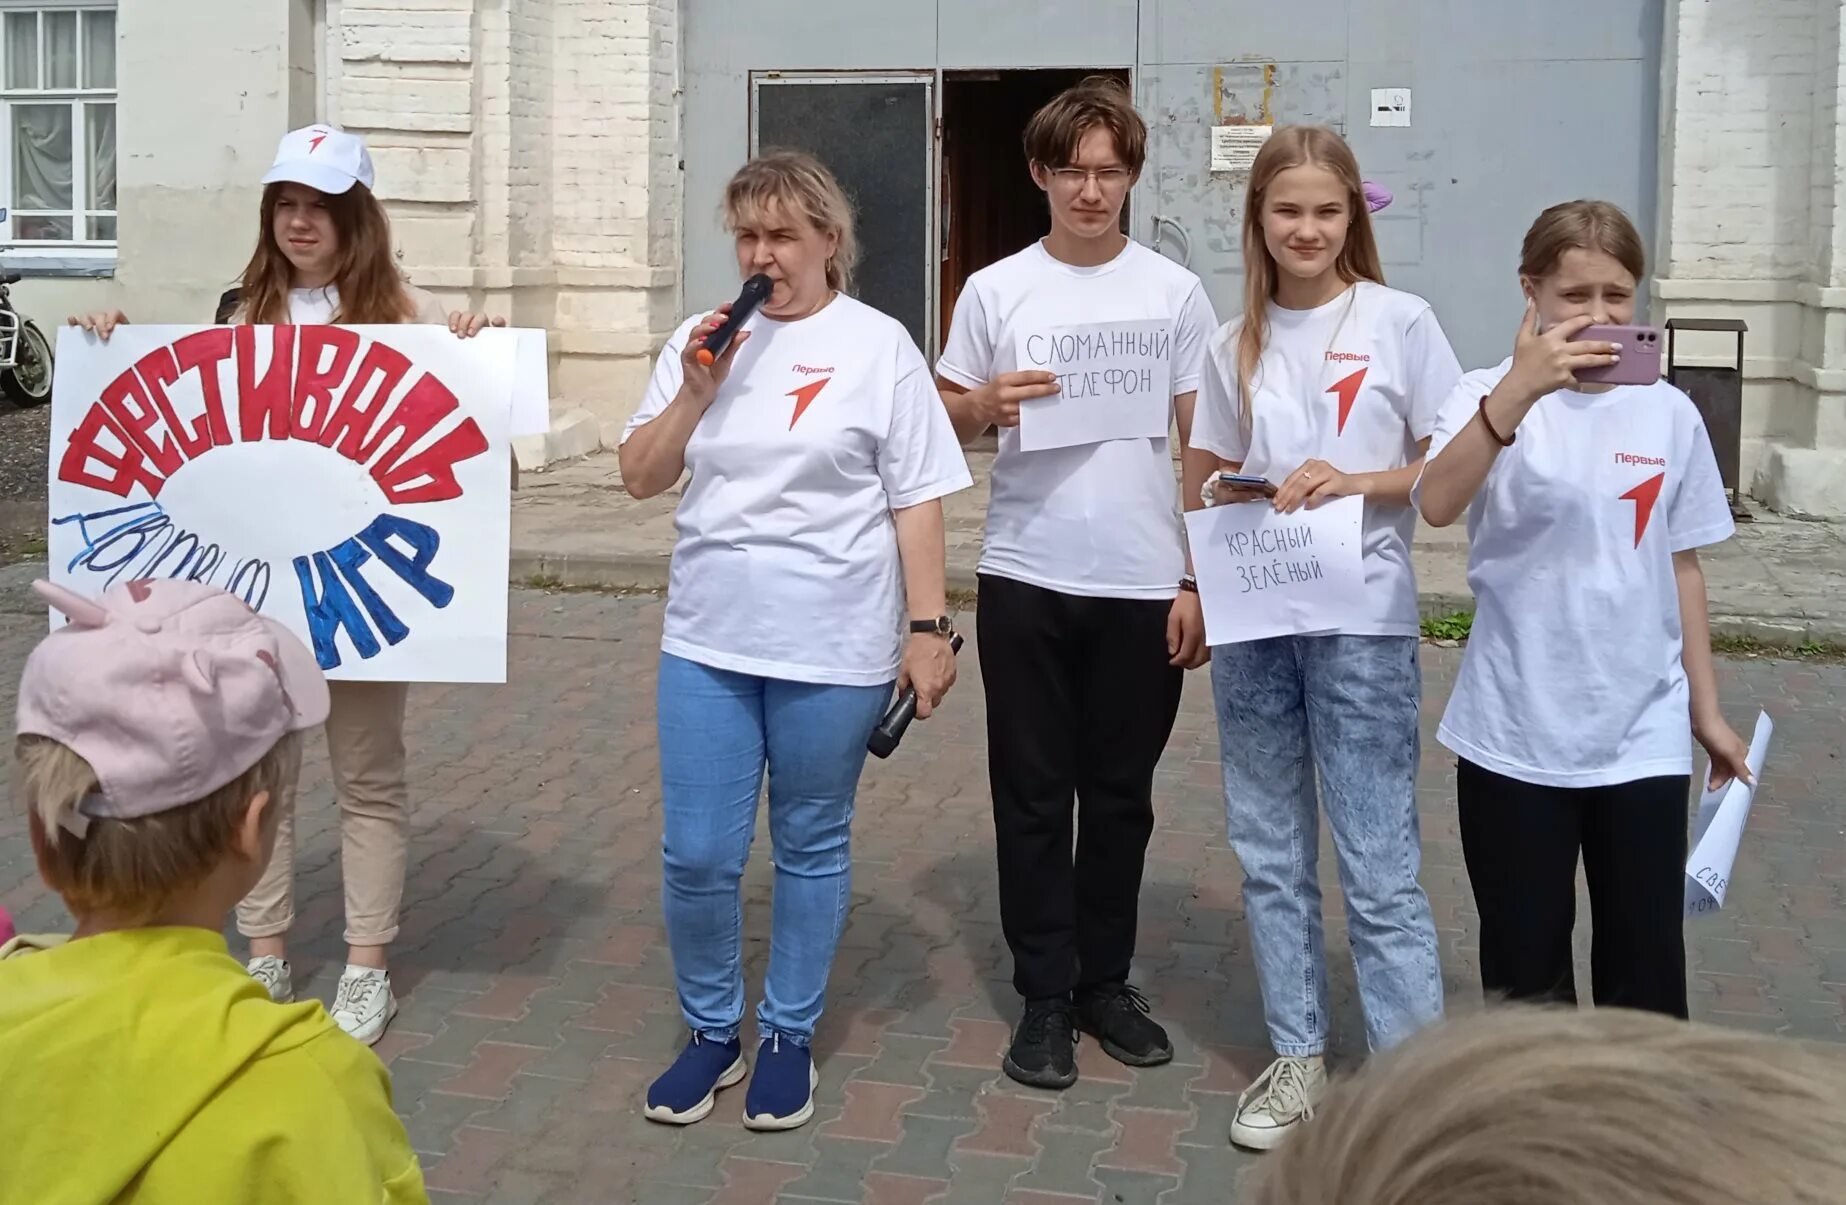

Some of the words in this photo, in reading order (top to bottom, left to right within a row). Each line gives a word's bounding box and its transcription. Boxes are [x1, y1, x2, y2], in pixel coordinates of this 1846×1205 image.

[1027, 328, 1169, 365] СЛОМАННЫЙ
[1324, 351, 1370, 364] Первые
[792, 364, 835, 376] Первые
[1056, 369, 1151, 399] ТЕЛЕФОН
[58, 325, 489, 504] ФЕСТИВАЛЬ
[1615, 452, 1666, 467] Первые
[1236, 555, 1323, 593] ЗЕЛЁНЫЙ
[293, 513, 455, 670] ИГР
[1696, 866, 1727, 894] СВЕ
